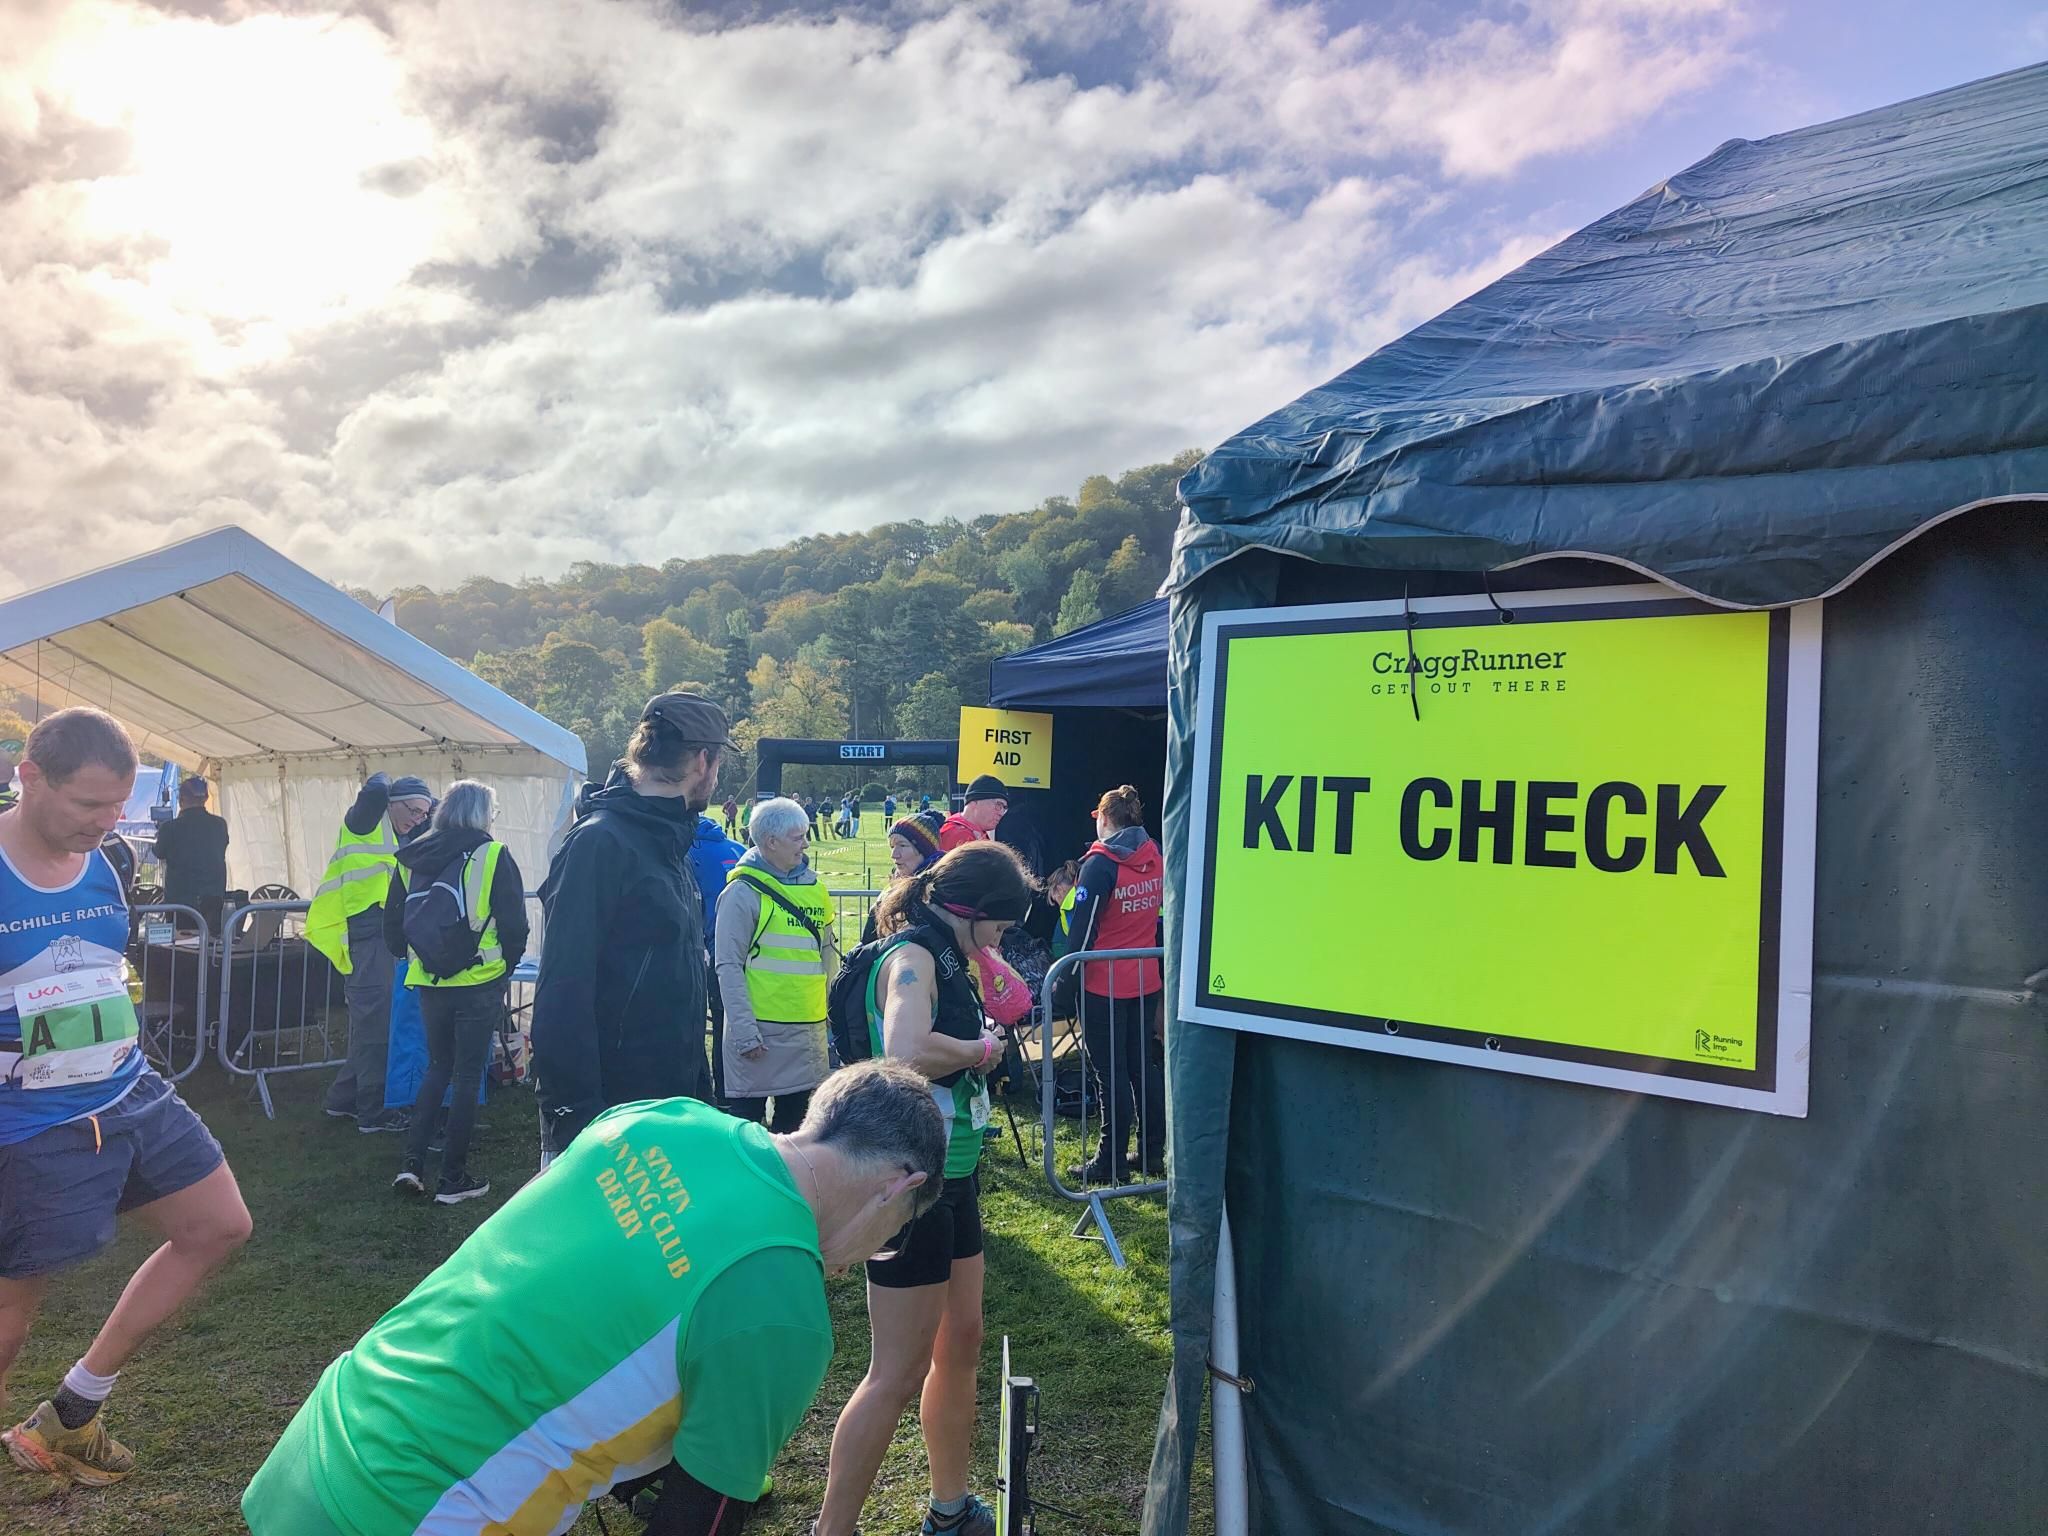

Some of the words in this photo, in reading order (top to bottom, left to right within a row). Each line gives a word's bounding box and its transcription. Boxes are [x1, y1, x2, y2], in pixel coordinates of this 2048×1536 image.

[1371, 683, 1409, 695] GET
[1430, 682, 1471, 694] OUT
[1492, 680, 1566, 693] THERE
[984, 728, 1032, 746] FIRST
[841, 746, 883, 758] START
[992, 751, 1021, 767] AID
[1242, 774, 1371, 855] KIT
[1400, 776, 1728, 879] CHECK
[0, 911, 72, 934] ACHILLE
[76, 905, 114, 921] RATTI
[28, 985, 64, 1000] UKA
[28, 1015, 57, 1056] A
[1713, 1035, 1743, 1047] Running
[1713, 1043, 1727, 1052] Imp
[642, 1146, 691, 1215] SINFIN
[596, 1168, 643, 1239] DERBY
[650, 1212, 690, 1279] CLUB
